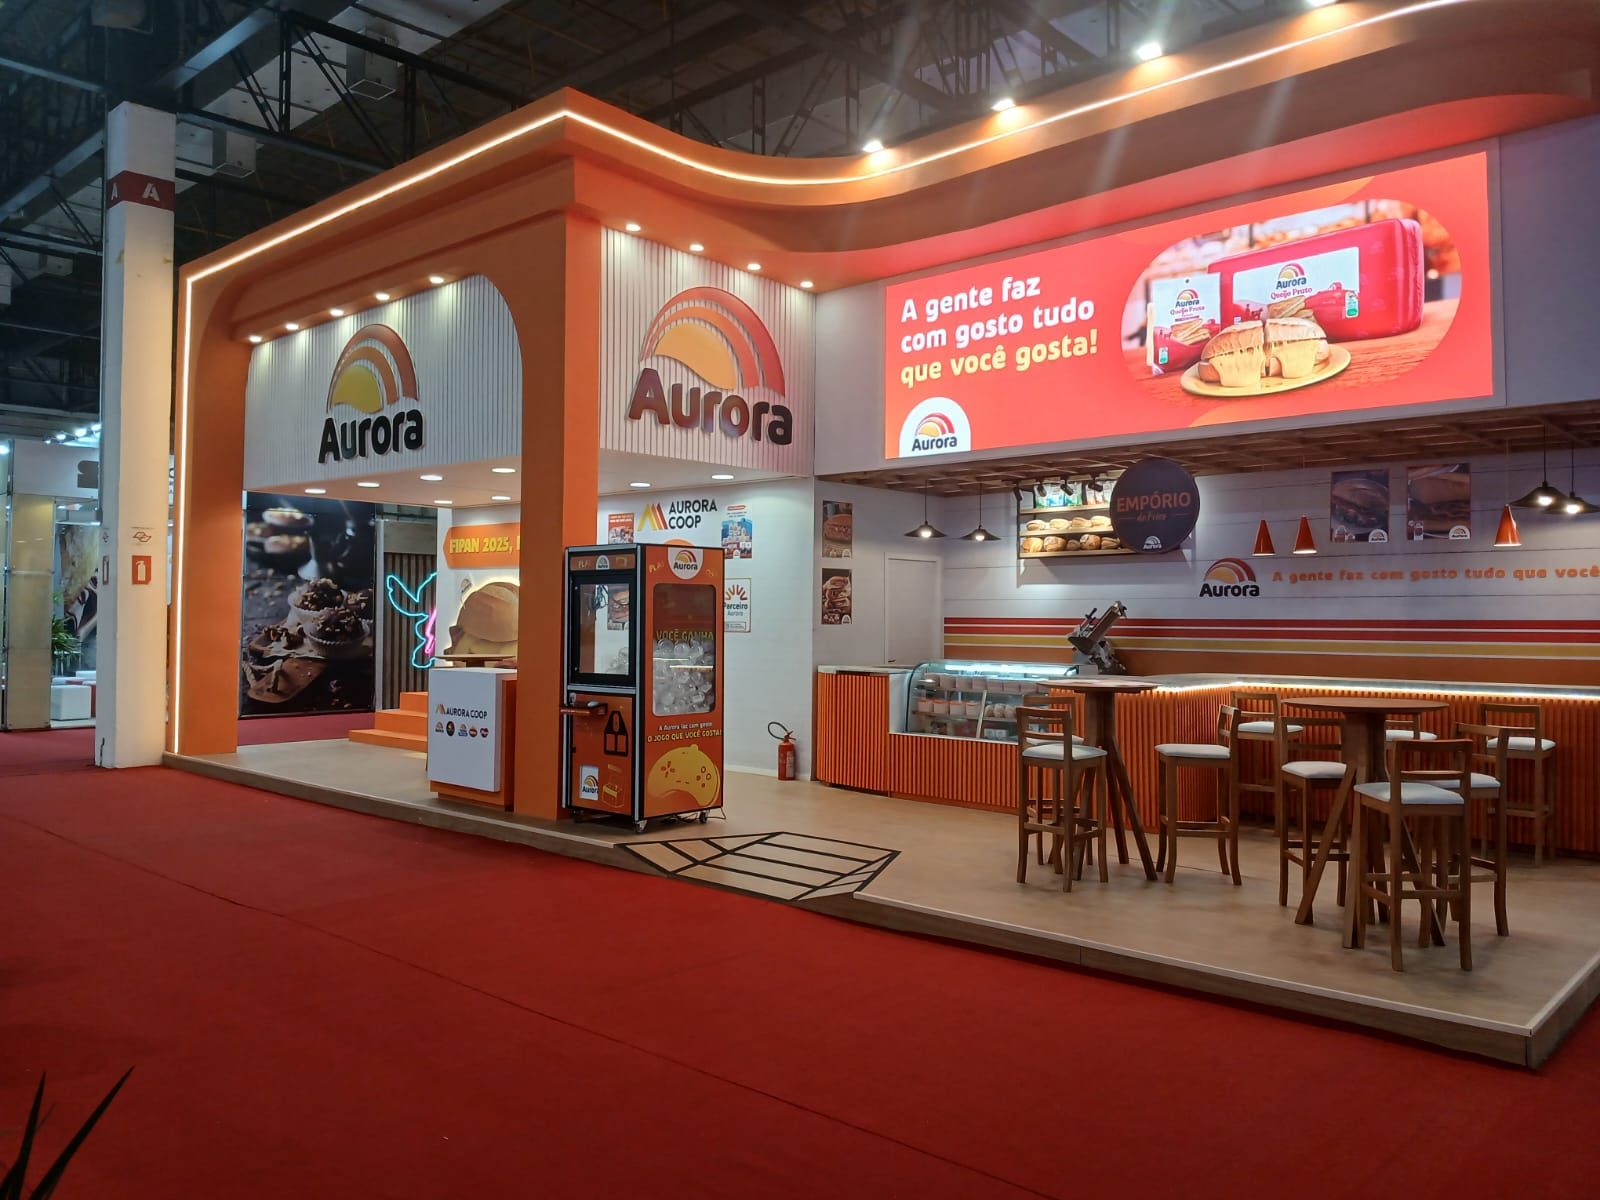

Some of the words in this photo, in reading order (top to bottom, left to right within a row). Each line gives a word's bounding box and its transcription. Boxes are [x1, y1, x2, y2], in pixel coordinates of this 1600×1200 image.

[142, 182, 161, 202] A
[1276, 277, 1307, 290] Aurora
[901, 299, 918, 323] A
[925, 286, 993, 323] gente
[1002, 276, 1041, 302] faz
[1271, 289, 1291, 300] Queijo
[1292, 287, 1313, 296] Prato
[1175, 299, 1200, 308] Aurora
[901, 328, 947, 353] com
[955, 313, 1023, 349] gosto
[1033, 297, 1095, 329] tudo
[900, 361, 942, 389] que
[951, 344, 1006, 376] você
[1015, 328, 1098, 372] gosta!
[627, 367, 793, 446] Aurora
[318, 408, 423, 464] Aurora
[912, 436, 958, 452] Aurora
[668, 499, 718, 514] AURORA
[1117, 490, 1191, 513] EMPÓRIO
[668, 515, 702, 530] COOP
[449, 538, 480, 553] FIPAN
[482, 536, 513, 553] 2025,
[673, 561, 698, 571] Aurora
[1272, 571, 1283, 582] A
[1289, 570, 1333, 584] gente
[1339, 569, 1364, 581] faz
[1371, 570, 1404, 580] com
[1409, 568, 1458, 582] gosto
[1464, 567, 1506, 579] tudo
[1513, 568, 1547, 581] que
[1554, 565, 1600, 578] você
[1199, 583, 1260, 598] Aurora
[656, 628, 680, 641] VOCÊ
[446, 707, 469, 718] AURORA
[470, 709, 487, 720] COOP
[654, 734, 670, 742] JOGO
[671, 732, 683, 740] QUE
[685, 730, 700, 739] VOCÊ
[582, 785, 599, 794] Auror
